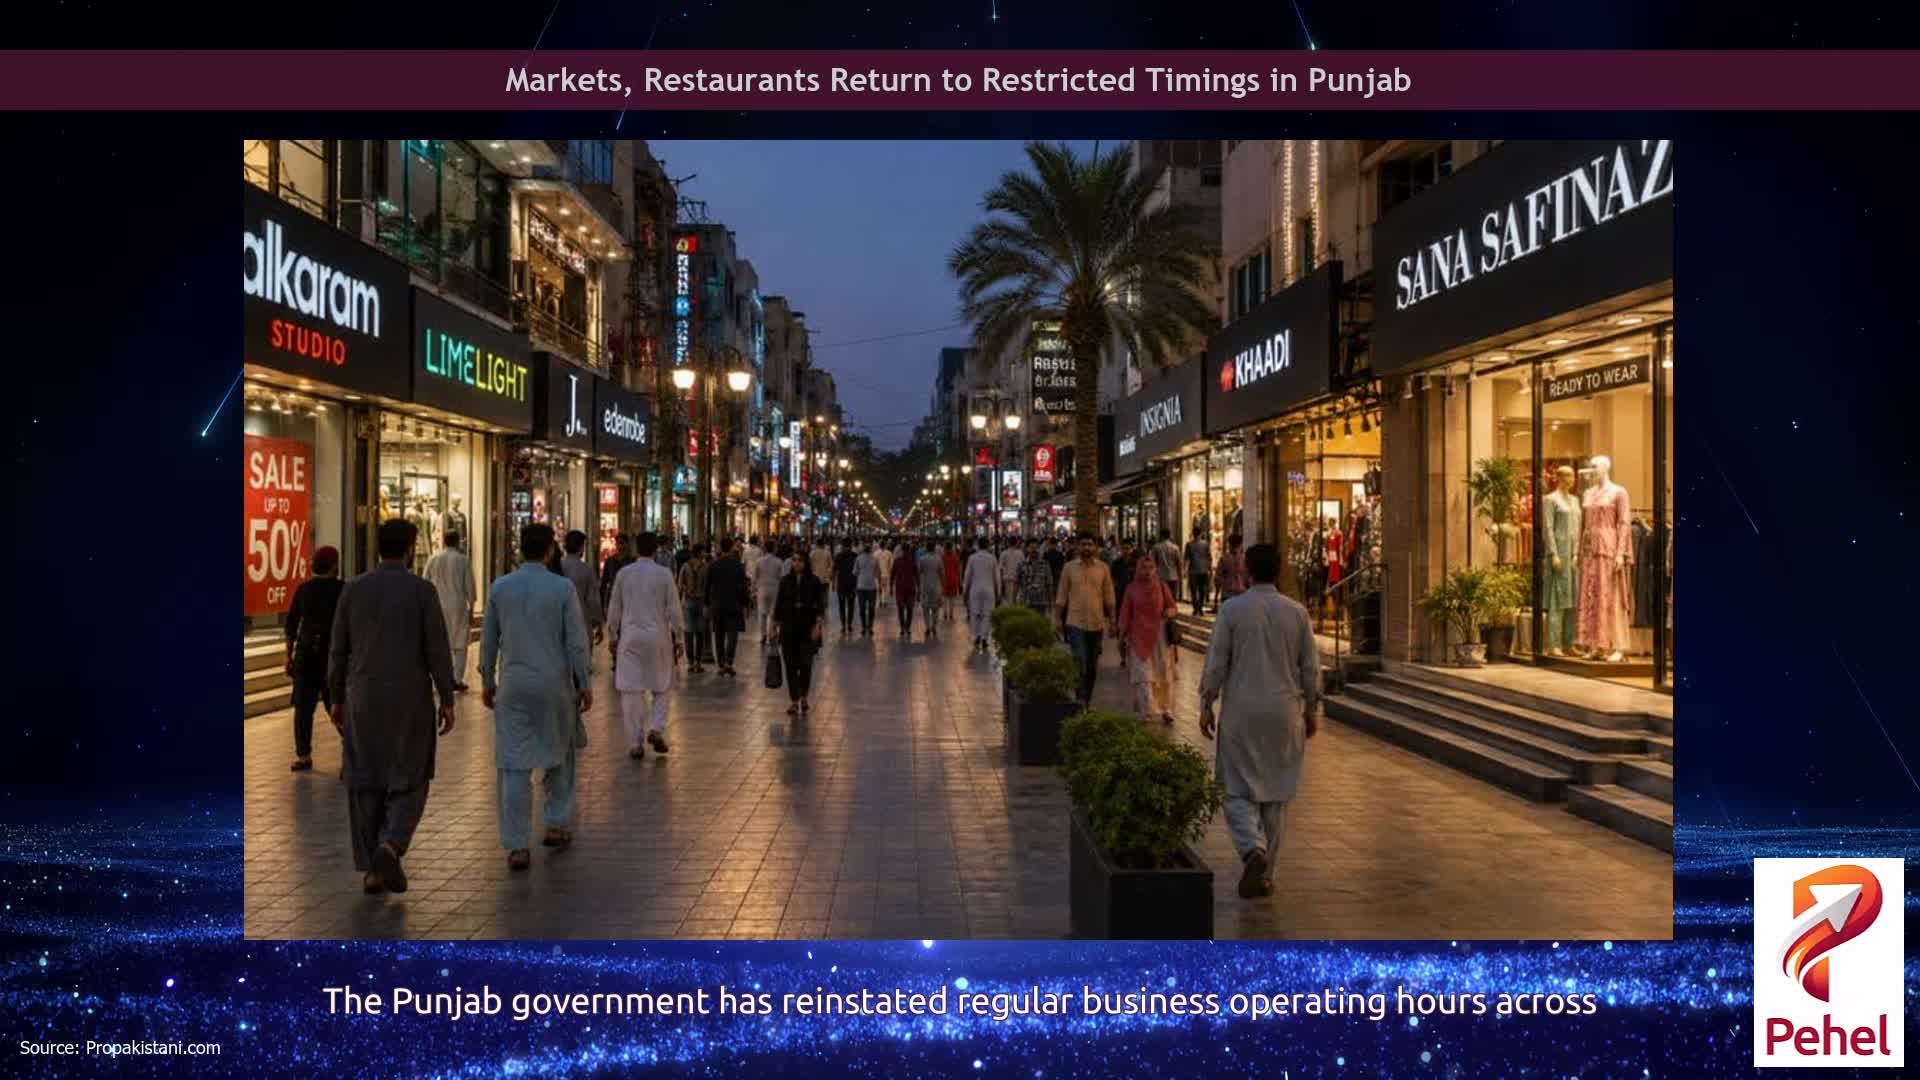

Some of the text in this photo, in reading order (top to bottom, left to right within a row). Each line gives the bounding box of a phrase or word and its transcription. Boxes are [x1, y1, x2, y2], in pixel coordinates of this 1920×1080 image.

[1397, 140, 1674, 310] SANA SAFINAZ
[244, 219, 380, 338] alkaram
[271, 320, 346, 365] STUDIO
[426, 328, 528, 402] LIMELIGHT
[1235, 329, 1290, 389] KHAADI
[1550, 364, 1638, 397] READY TO WEAR
[1140, 394, 1182, 438] INSIGNIA
[249, 451, 306, 492] SALE
[264, 498, 291, 515] UP TO
[247, 518, 307, 583] 50%
[267, 587, 288, 605] OFF
